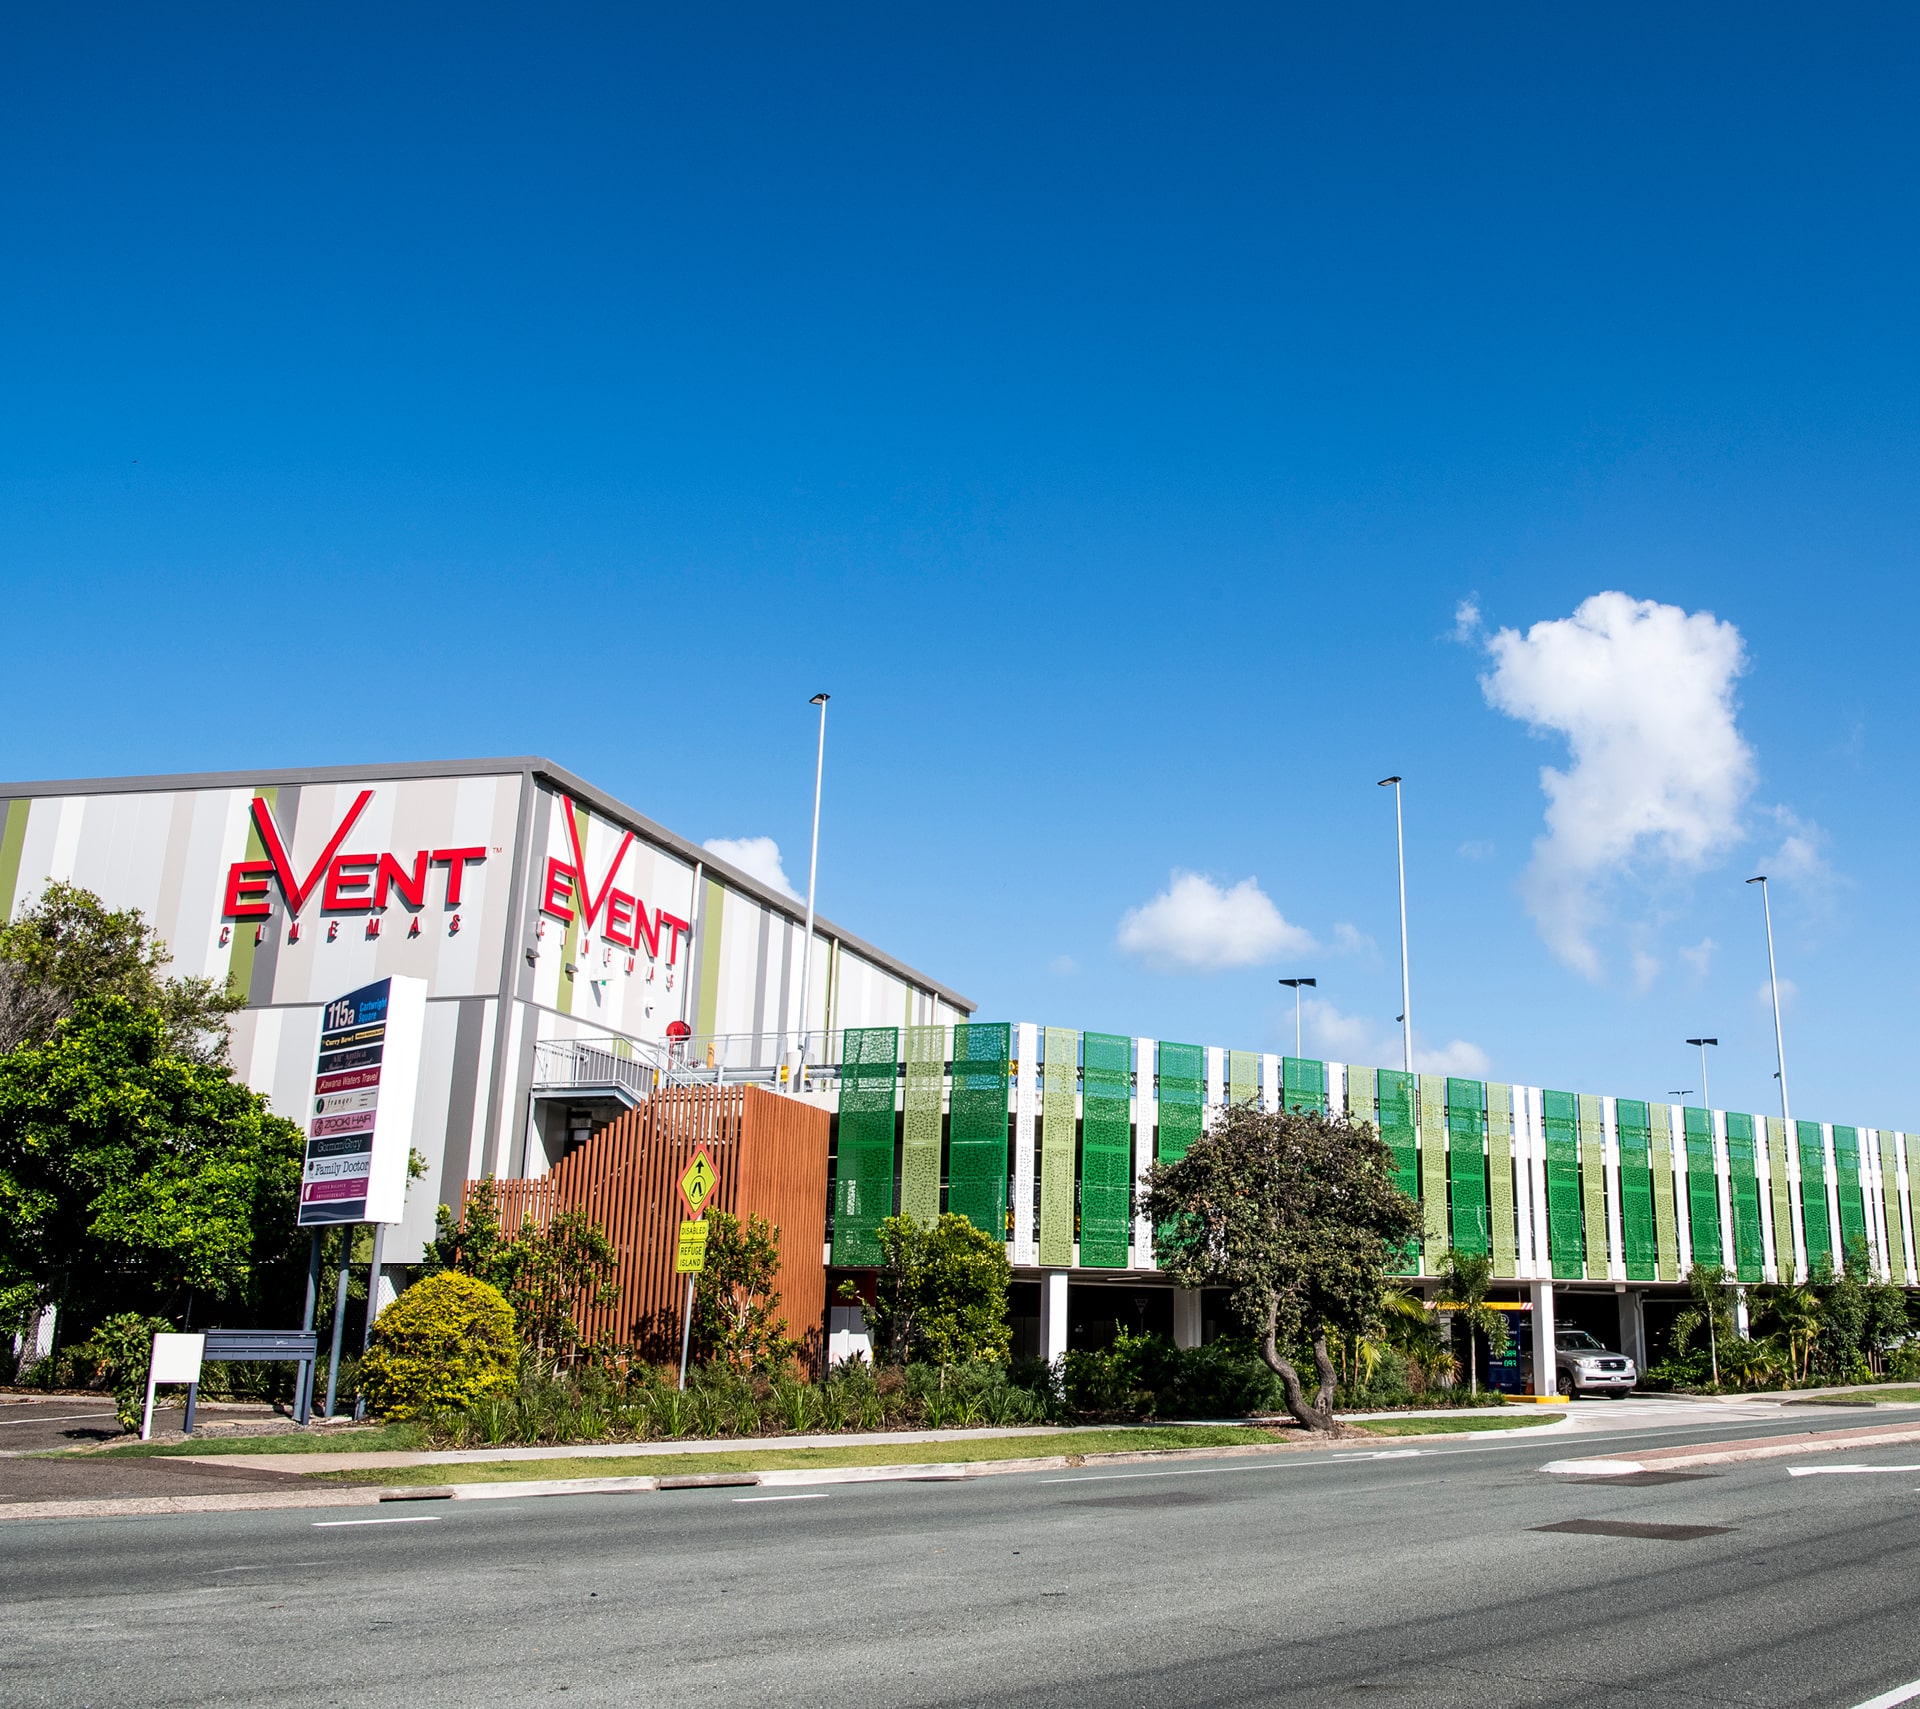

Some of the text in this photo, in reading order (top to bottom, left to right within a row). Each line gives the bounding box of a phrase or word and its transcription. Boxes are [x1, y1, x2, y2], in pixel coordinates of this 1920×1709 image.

[223, 789, 487, 918] EVENT
[543, 794, 689, 966] EVENT
[219, 914, 461, 944] CINEMAS
[539, 921, 674, 988] CINEMAS
[328, 1000, 355, 1029] 115a
[358, 1011, 377, 1023] Square
[325, 1038, 340, 1046] Curry
[341, 1035, 354, 1044] Bowl
[317, 1071, 379, 1094] Kawana Waters Travel
[324, 1117, 351, 1129] ZOOKI
[352, 1114, 372, 1125] HAIR
[315, 1160, 369, 1176] Family Doctor
[681, 1226, 706, 1235] DISABLED
[680, 1246, 702, 1255] REFUGE
[680, 1258, 701, 1267] ISLAND
